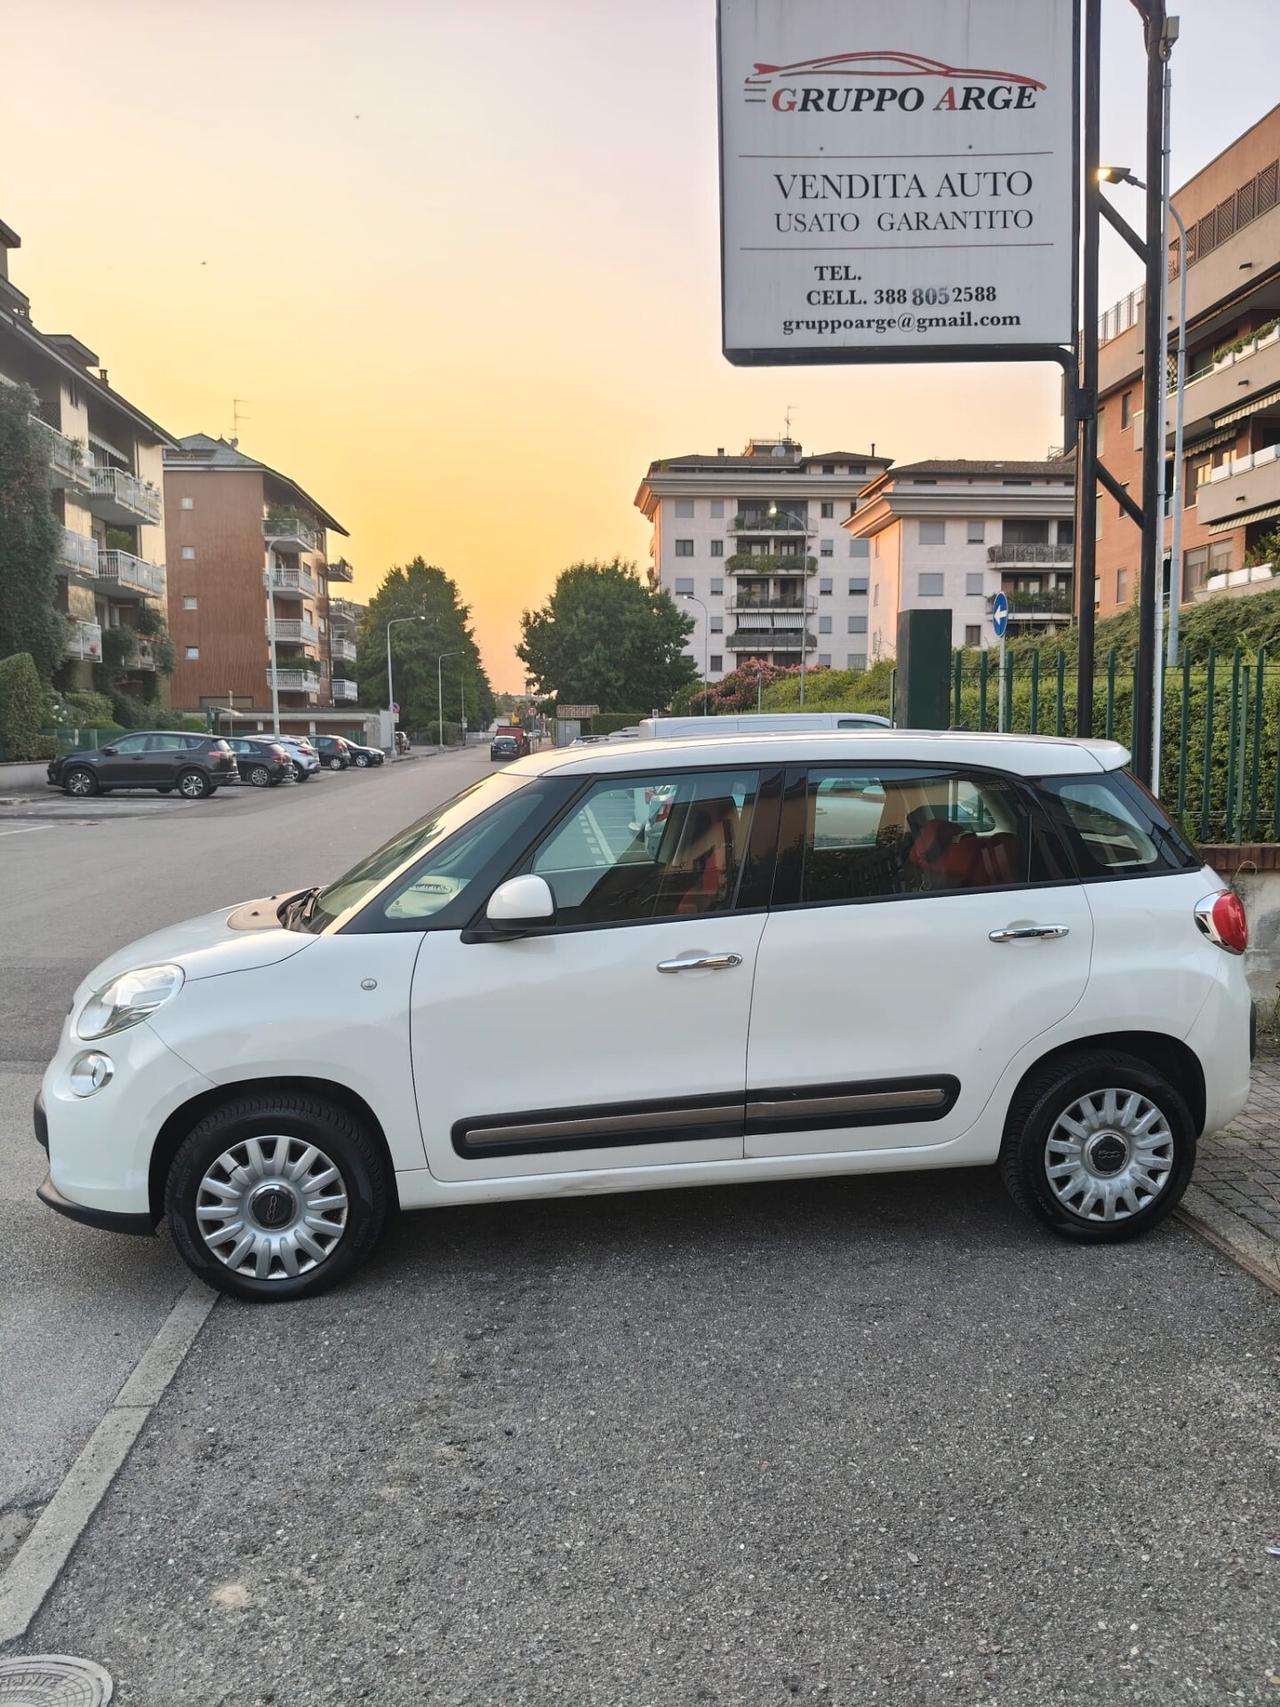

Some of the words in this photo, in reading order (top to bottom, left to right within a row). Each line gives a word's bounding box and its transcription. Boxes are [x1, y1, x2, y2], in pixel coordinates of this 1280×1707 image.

[771, 87, 925, 112] GRUPPO
[932, 85, 1037, 111] ARGE
[773, 173, 928, 200] VENDITA
[935, 170, 1033, 198] AUTO
[775, 212, 860, 233] USATO
[877, 209, 1034, 232] GARANTITO
[814, 265, 862, 282] TEL.
[806, 289, 867, 306] CELL.
[874, 289, 907, 305] 388
[912, 287, 950, 307] 805
[952, 286, 997, 303] 2588
[783, 311, 1022, 336] gruppoarge@gmail.com
